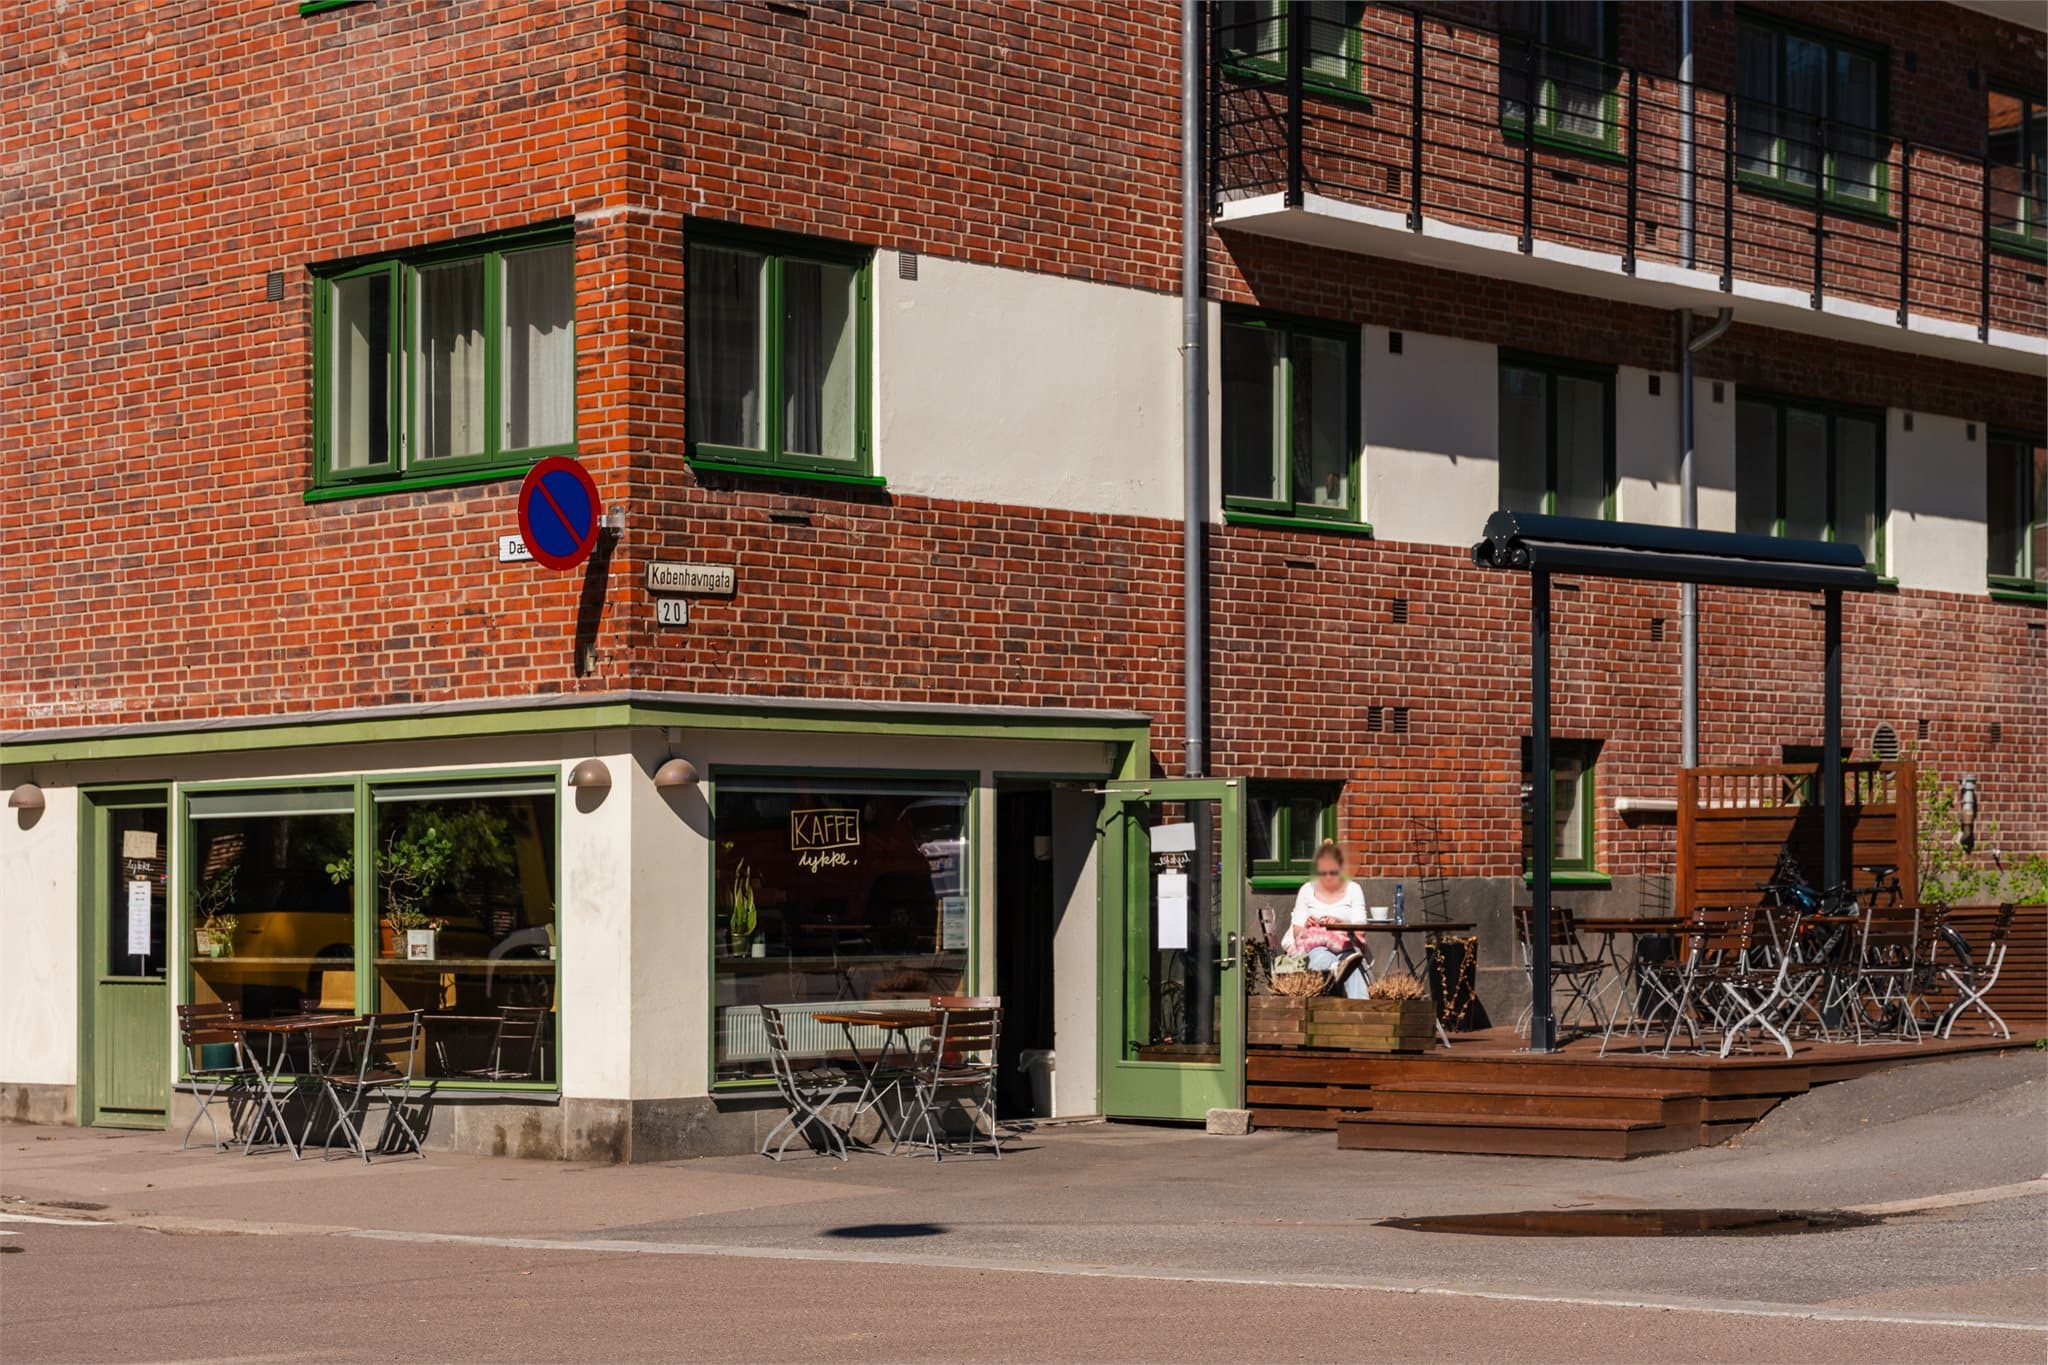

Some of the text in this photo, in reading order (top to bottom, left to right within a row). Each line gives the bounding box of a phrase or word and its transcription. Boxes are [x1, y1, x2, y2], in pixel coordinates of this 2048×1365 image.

[652, 566, 730, 591] Københavngata
[663, 602, 681, 622] 20
[794, 814, 857, 846] KAFFE
